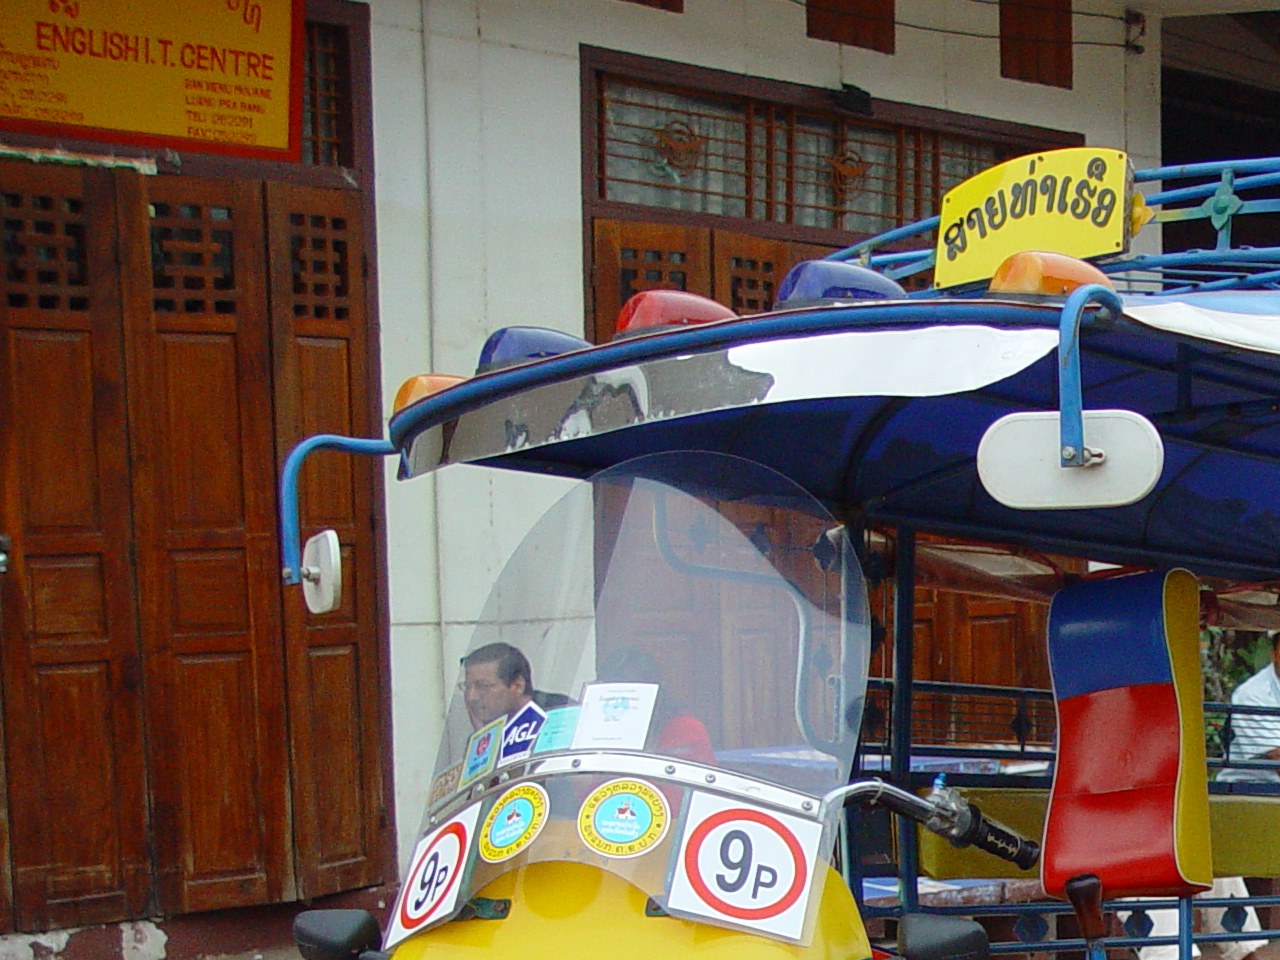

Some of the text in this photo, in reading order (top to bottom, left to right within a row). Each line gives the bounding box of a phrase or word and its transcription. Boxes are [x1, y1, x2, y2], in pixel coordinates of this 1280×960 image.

[36, 21, 139, 63] ENGLISH
[180, 43, 275, 80] CENTRE
[503, 720, 538, 746] AGL
[414, 851, 449, 911] 9P
[716, 829, 778, 900] 9P
